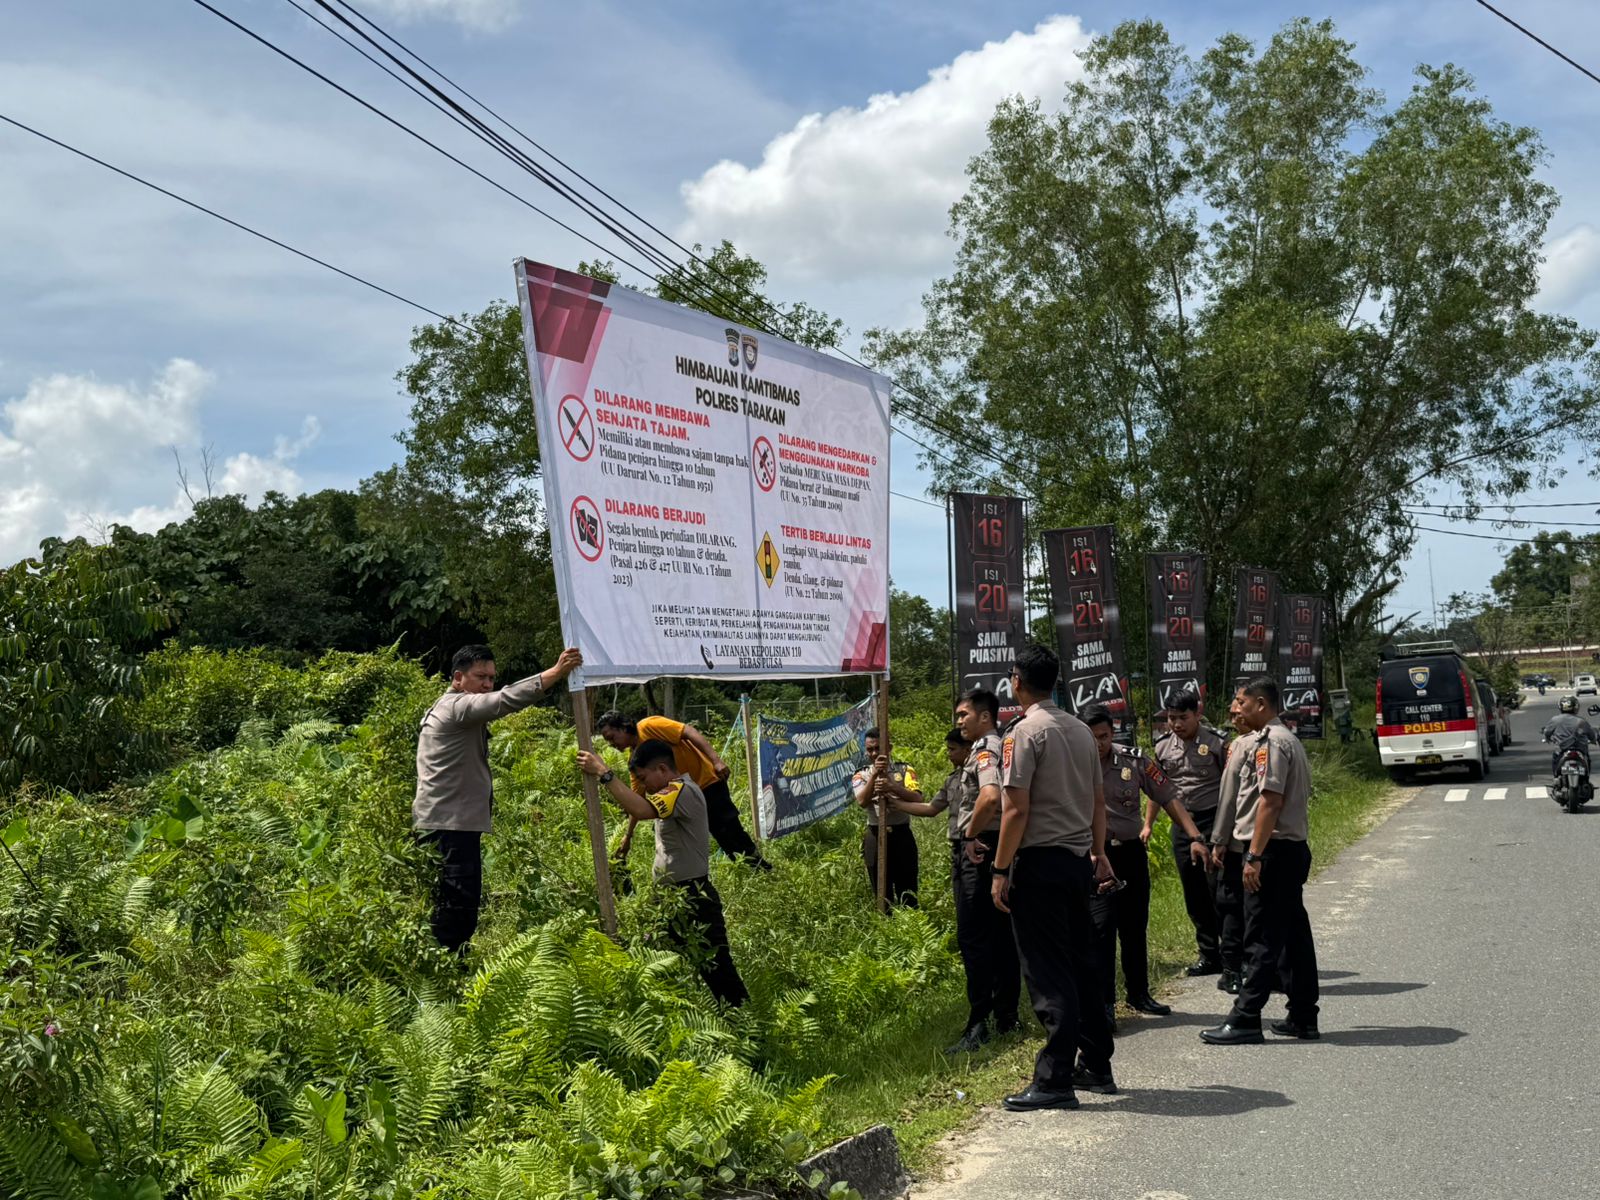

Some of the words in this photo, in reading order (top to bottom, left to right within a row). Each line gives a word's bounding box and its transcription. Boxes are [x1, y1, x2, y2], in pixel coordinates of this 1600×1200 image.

[676, 356, 738, 388] HIMBAUAN
[741, 374, 800, 406] KAMTIBMAS
[594, 388, 652, 415] DILARANG
[655, 404, 710, 427] MEMBAWA
[696, 387, 738, 413] POLRES
[740, 398, 785, 426] TARAKAN
[596, 408, 648, 432] SENJATA
[650, 420, 690, 441] TAJAM.
[598, 427, 633, 446] Memiliki
[634, 436, 650, 448] atau
[652, 441, 690, 457] membawa
[692, 448, 713, 462] sajam
[714, 453, 734, 466] tanpa
[778, 433, 816, 450] DILARANG
[818, 442, 870, 464] MENGEDARKAN
[872, 456, 876, 466] &
[600, 444, 626, 462] Pidana
[628, 450, 657, 467] penjara
[658, 456, 684, 472] hingga
[685, 464, 694, 473] 10
[694, 462, 716, 477] tahun
[779, 448, 836, 470] MENGGUNAKAN
[837, 462, 870, 478] NARKOBA
[601, 461, 614, 476] (UU
[617, 465, 647, 480] Darurat
[650, 470, 662, 484] No.
[663, 475, 670, 484] 12
[672, 474, 696, 489] Tahun
[697, 479, 713, 493] 1951)
[606, 498, 659, 520] DILARANG
[663, 508, 706, 525] BERJUDI
[983, 503, 997, 515] ISI
[606, 520, 630, 536] Segala
[632, 523, 659, 539] bentuk
[660, 528, 694, 543] perjudian
[780, 525, 808, 540] TERTIB
[809, 530, 844, 545] BERLALU
[846, 534, 872, 550] LINTAS
[978, 518, 1002, 547] 16
[608, 538, 637, 554] Penjara
[638, 541, 664, 557] hingga
[666, 546, 674, 556] 10
[676, 546, 696, 559] tahun
[696, 548, 704, 560] &
[1073, 536, 1088, 547] ISI
[610, 554, 632, 570] (Pasal
[634, 559, 648, 571] 426
[649, 559, 656, 570] &
[659, 562, 670, 574] 427
[672, 560, 682, 573] UU
[684, 562, 691, 573] RI
[692, 562, 704, 575] No.
[710, 564, 732, 577] Tahun
[1070, 548, 1094, 572] 16
[1172, 561, 1184, 569] ISI
[612, 574, 632, 587] 2023)
[984, 569, 998, 580] ISI
[1170, 572, 1189, 592] 16
[978, 584, 1004, 612] 20
[1080, 590, 1093, 600] ISI
[1250, 586, 1266, 603] 16
[652, 604, 668, 614] JIKA
[668, 605, 695, 614] MELIHAT
[696, 606, 710, 616] DAN
[712, 608, 750, 618] MENGETAHUI
[752, 609, 774, 618] ADANYA
[775, 611, 802, 620] GANGGUAN
[1076, 602, 1100, 626] 20
[1174, 606, 1186, 615] ISI
[1295, 608, 1311, 624] 16
[654, 616, 684, 626] SEPERTI,
[685, 618, 720, 628] KERIBUTAN,
[764, 622, 802, 630] PENGANIAYAAN
[814, 624, 830, 632] TINDAK
[1170, 617, 1190, 637] 20
[1250, 624, 1264, 641] 20
[664, 629, 702, 639] KEJAHATAN,
[702, 630, 743, 640] KRIMINALITAS
[745, 632, 768, 640] LAINNYA
[770, 632, 786, 640] DAPAT
[978, 632, 1006, 648] SAMA
[714, 645, 750, 657] LAYANAN
[752, 646, 790, 657] KEPOLISIAN
[792, 646, 802, 657] 110
[970, 647, 1016, 664] PUASNYA
[1077, 640, 1104, 657] SAMA
[1168, 650, 1191, 661] SAMA
[1294, 642, 1312, 656] 20
[739, 658, 760, 668] BEBAS
[762, 658, 782, 668] PULSA
[1072, 652, 1112, 671] PUASNYA
[1245, 653, 1263, 662] SAMA
[1291, 667, 1310, 675] SAMA
[1405, 706, 1419, 714] CALL
[1420, 704, 1443, 714] CENTER
[1420, 714, 1430, 722] 110
[1404, 722, 1447, 734] POLISI
